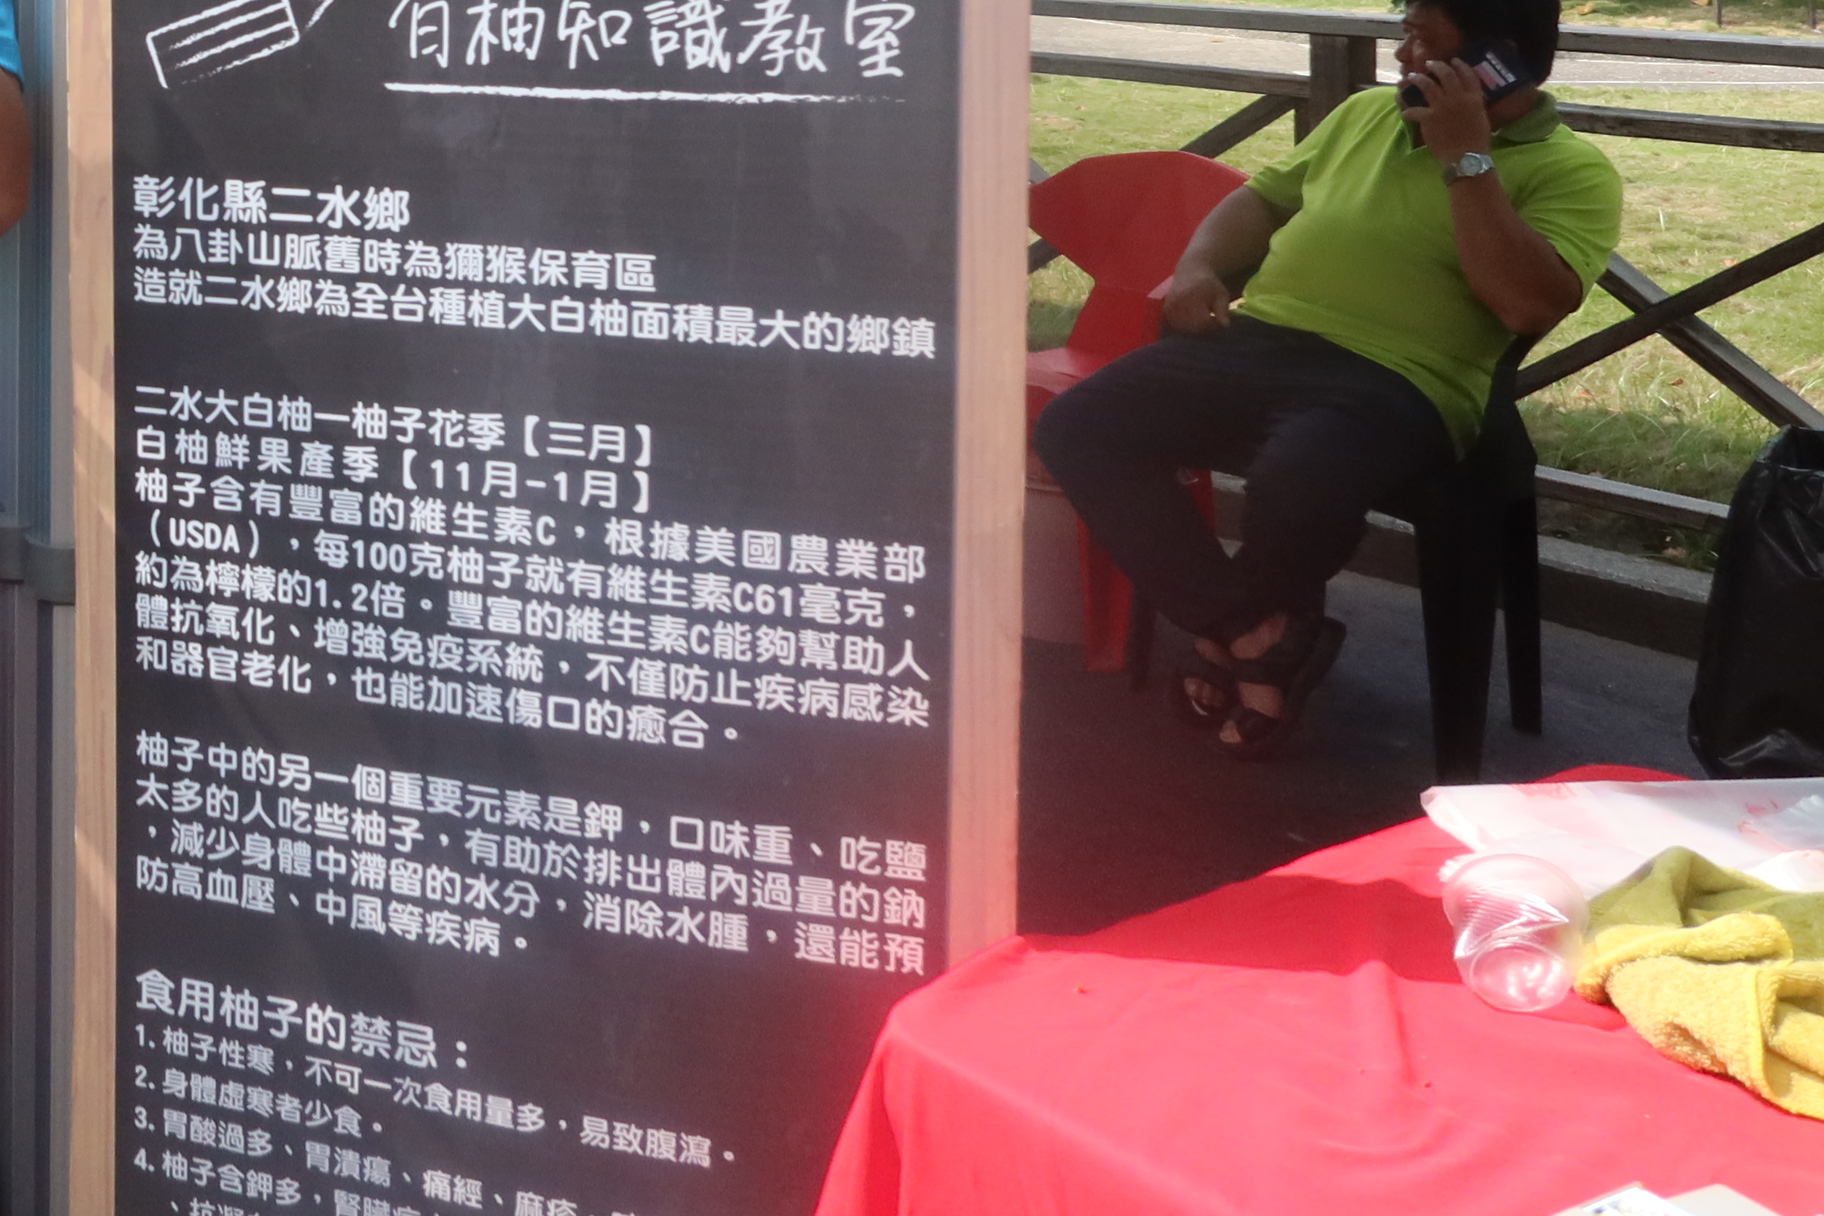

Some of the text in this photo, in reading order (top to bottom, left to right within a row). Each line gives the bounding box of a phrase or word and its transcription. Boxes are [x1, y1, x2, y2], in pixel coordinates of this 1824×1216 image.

[132, 173, 412, 233] 彰化縣二水鄉
[133, 265, 937, 360] 造就二水鄉為全台種植大白柚面積最大的鄉鎮
